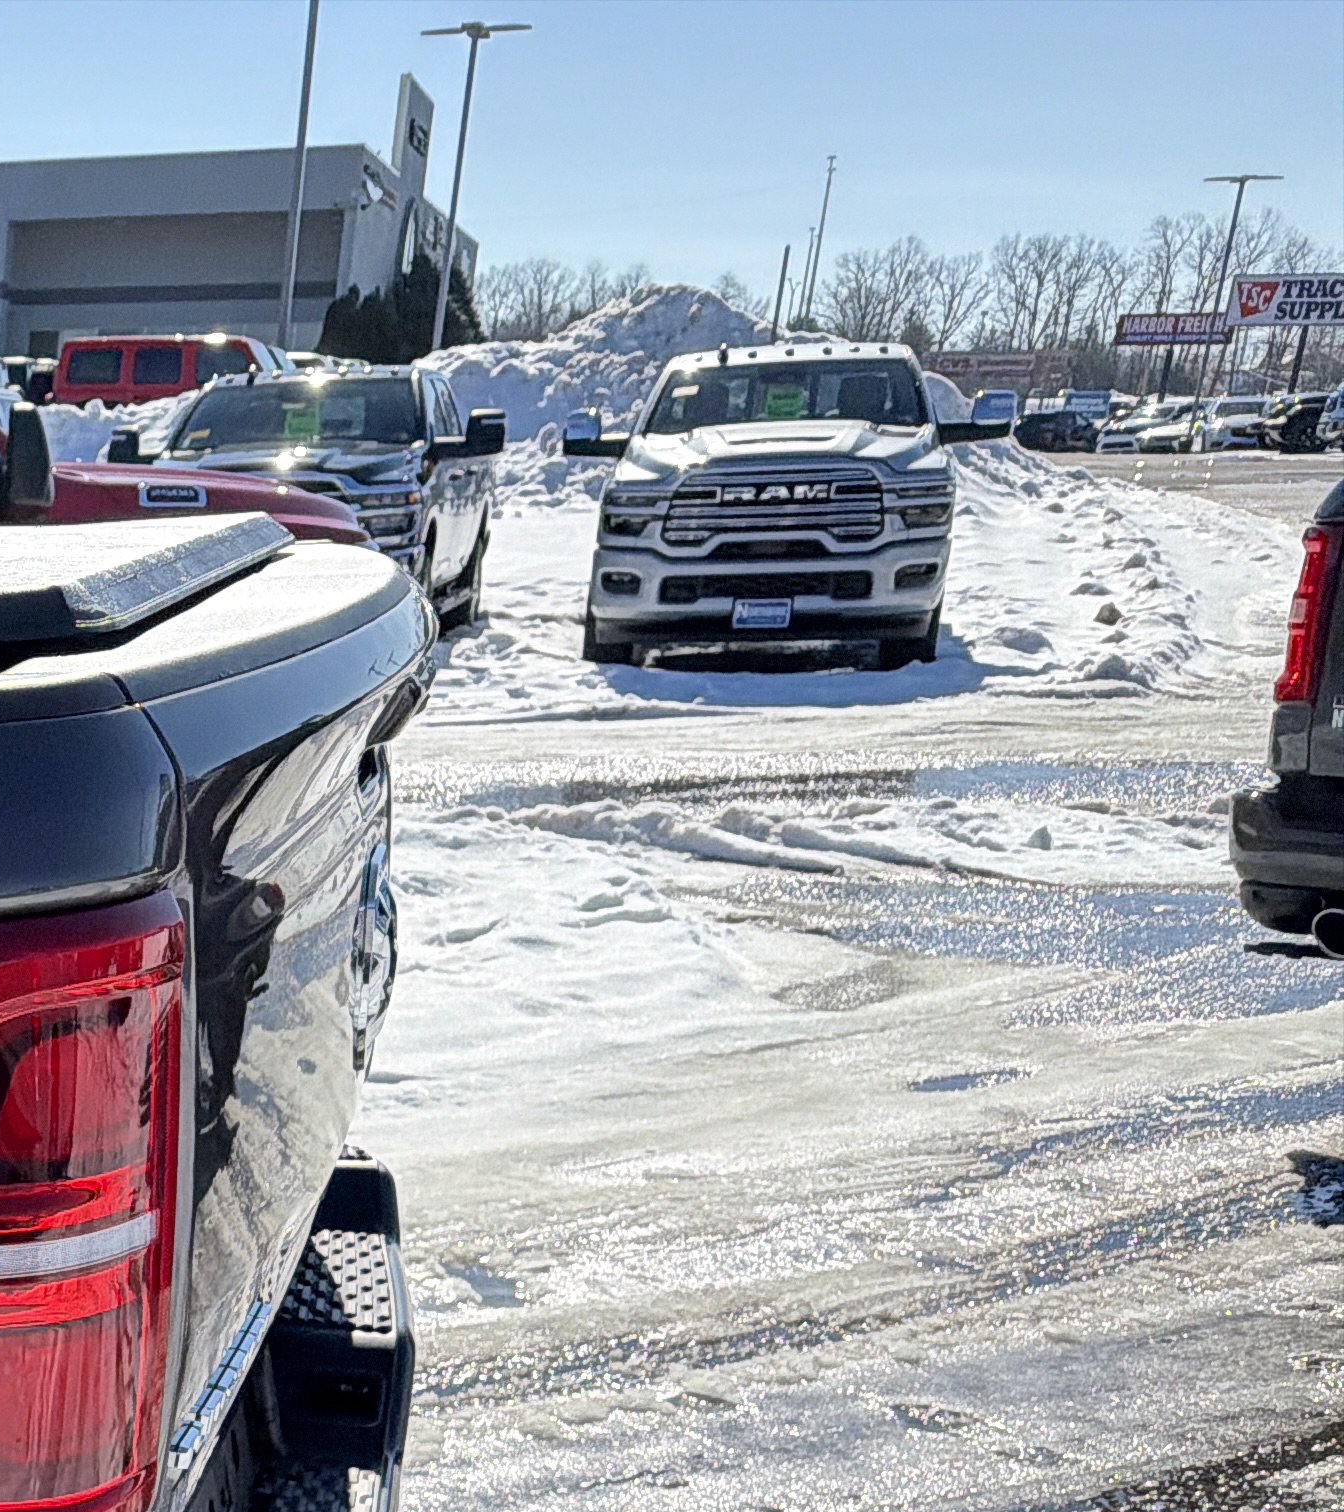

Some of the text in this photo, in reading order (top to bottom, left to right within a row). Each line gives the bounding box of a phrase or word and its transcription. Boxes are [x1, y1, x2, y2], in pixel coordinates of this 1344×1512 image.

[1240, 283, 1271, 311] TSC
[1122, 316, 1175, 333] HARBOR
[722, 484, 829, 500] RAM
